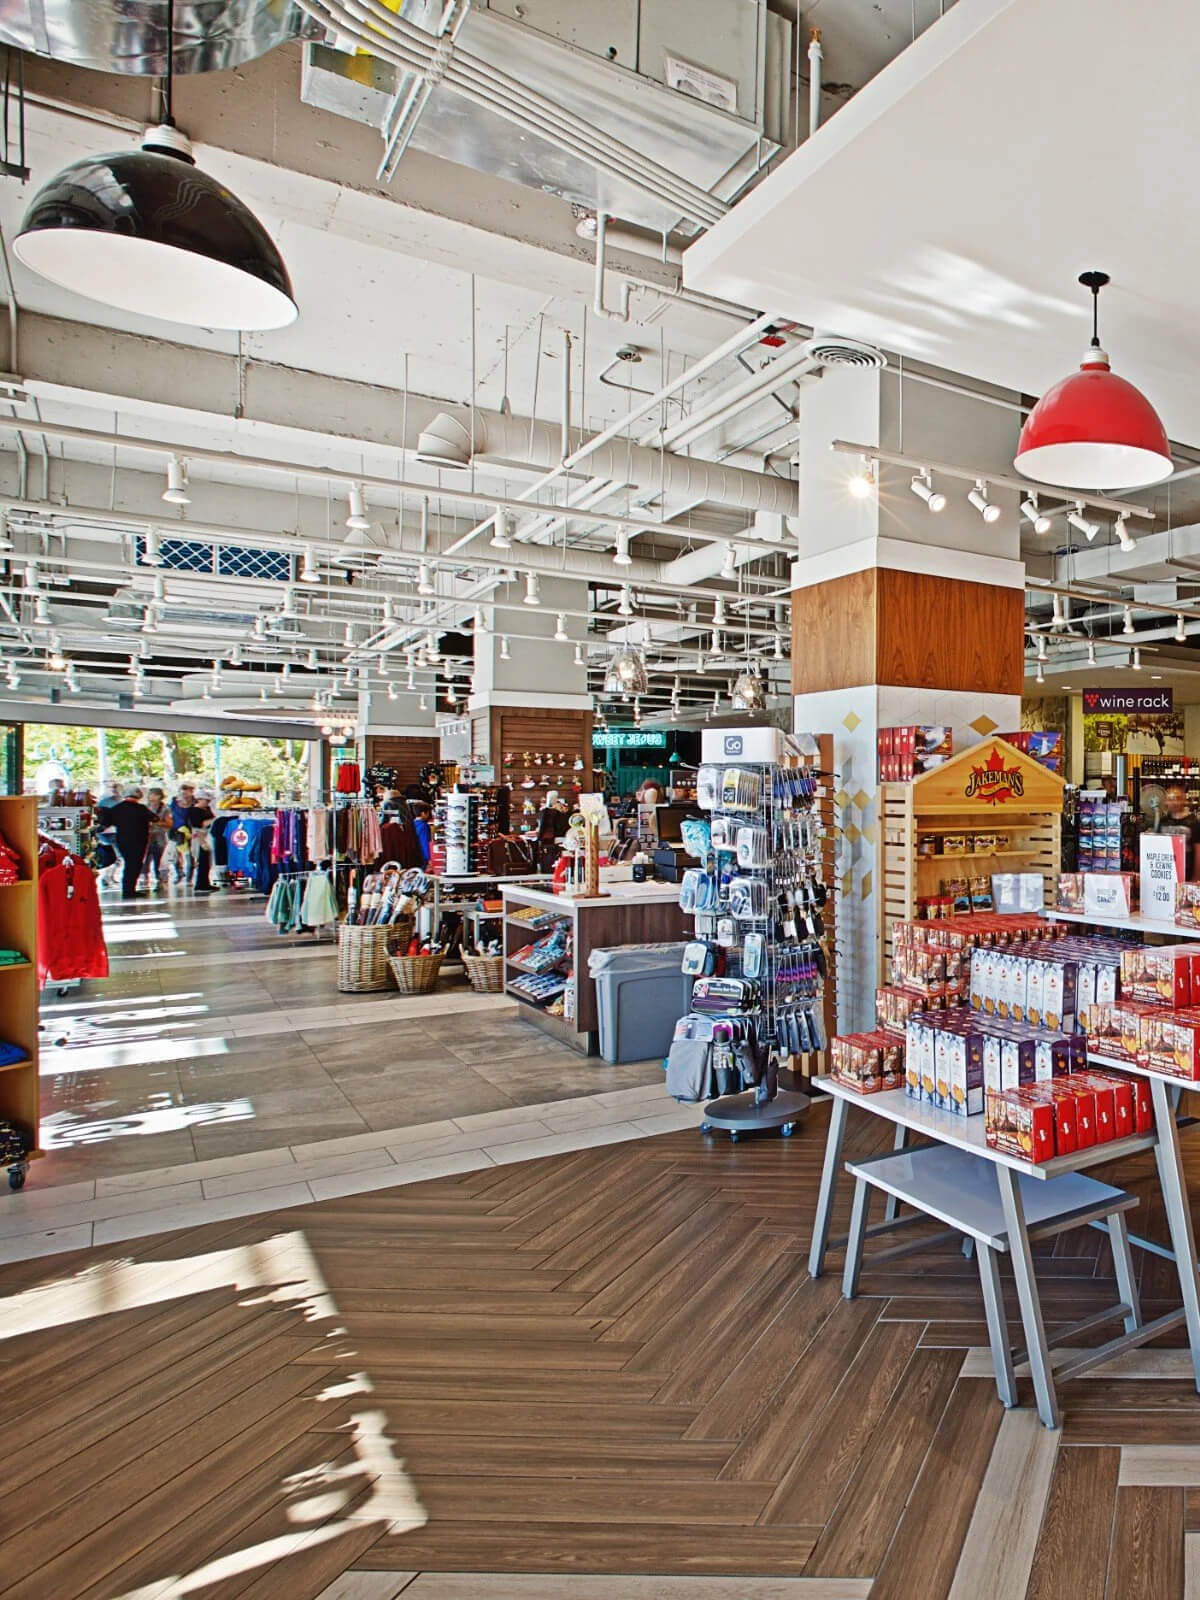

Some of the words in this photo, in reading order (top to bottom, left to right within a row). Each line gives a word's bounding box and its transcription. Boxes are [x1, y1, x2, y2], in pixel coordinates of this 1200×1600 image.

[1100, 695, 1134, 708] wine
[1137, 693, 1169, 708] rack
[592, 733, 625, 745] WEET
[1150, 869, 1172, 880] COOKIES
